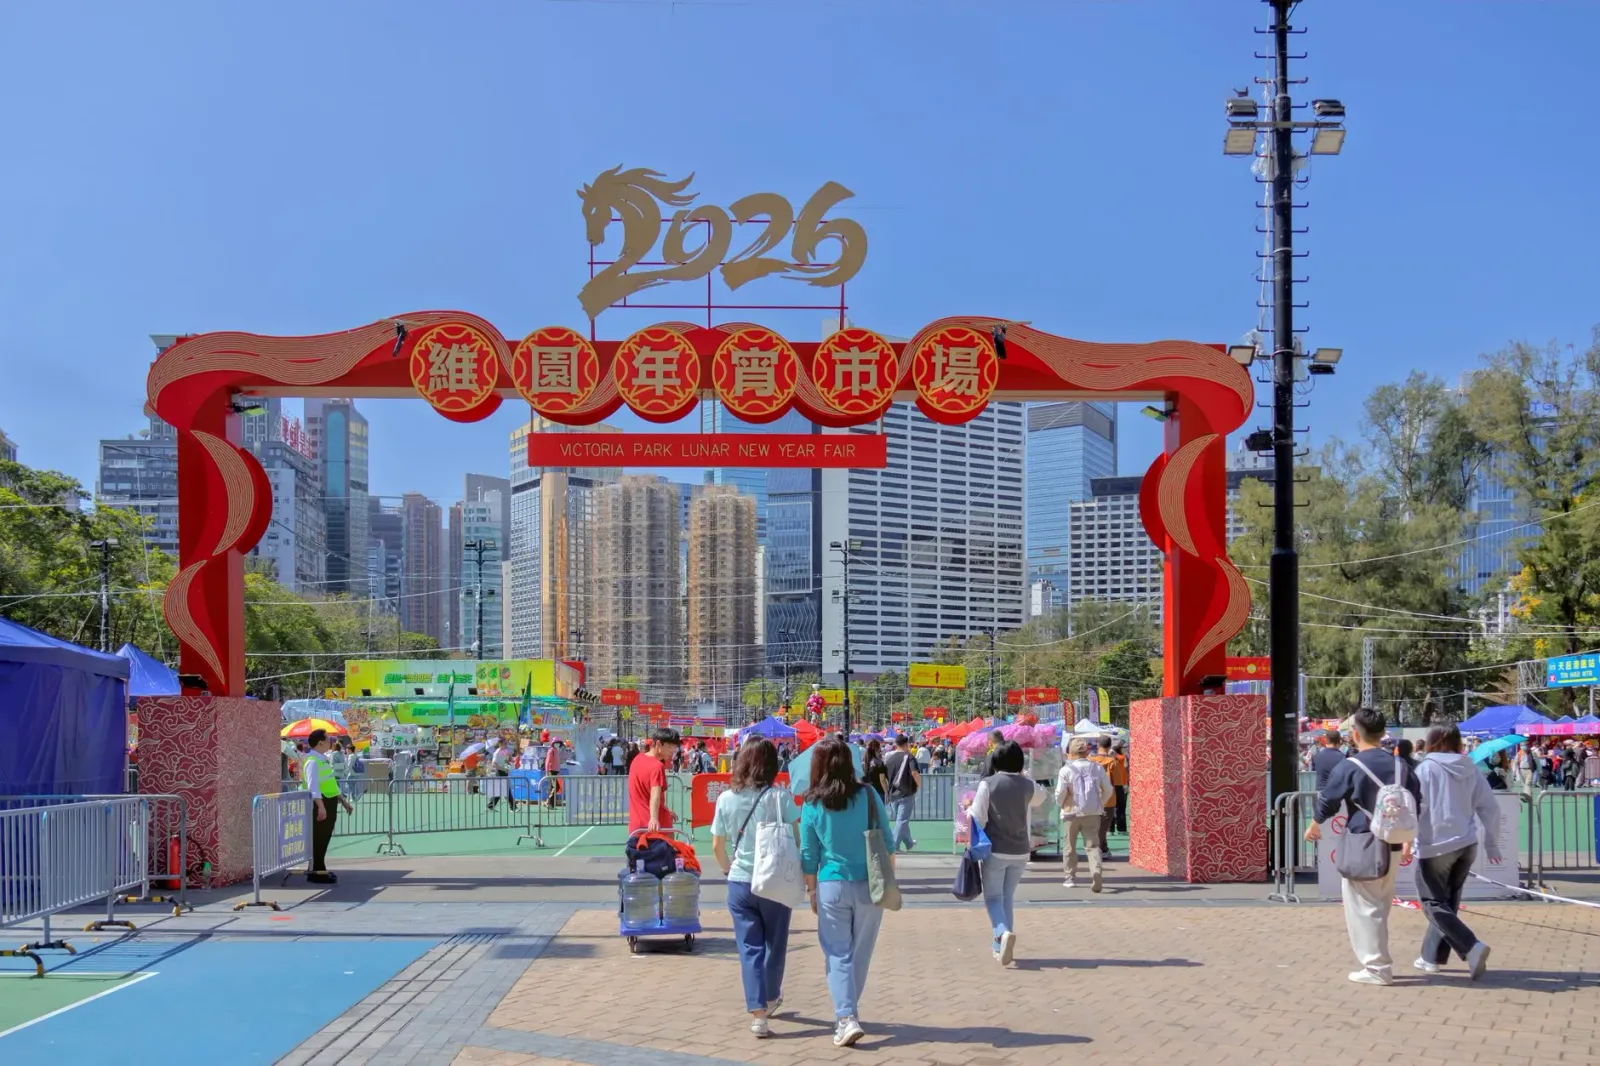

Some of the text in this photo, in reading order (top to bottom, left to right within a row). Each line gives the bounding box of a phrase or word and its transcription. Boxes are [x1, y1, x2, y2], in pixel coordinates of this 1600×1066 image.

[576, 163, 868, 322] 2026
[428, 343, 980, 397] 維園年宵市場
[559, 442, 856, 458] VICTORIA PARK LUNAR NEW YEAR FAIR
